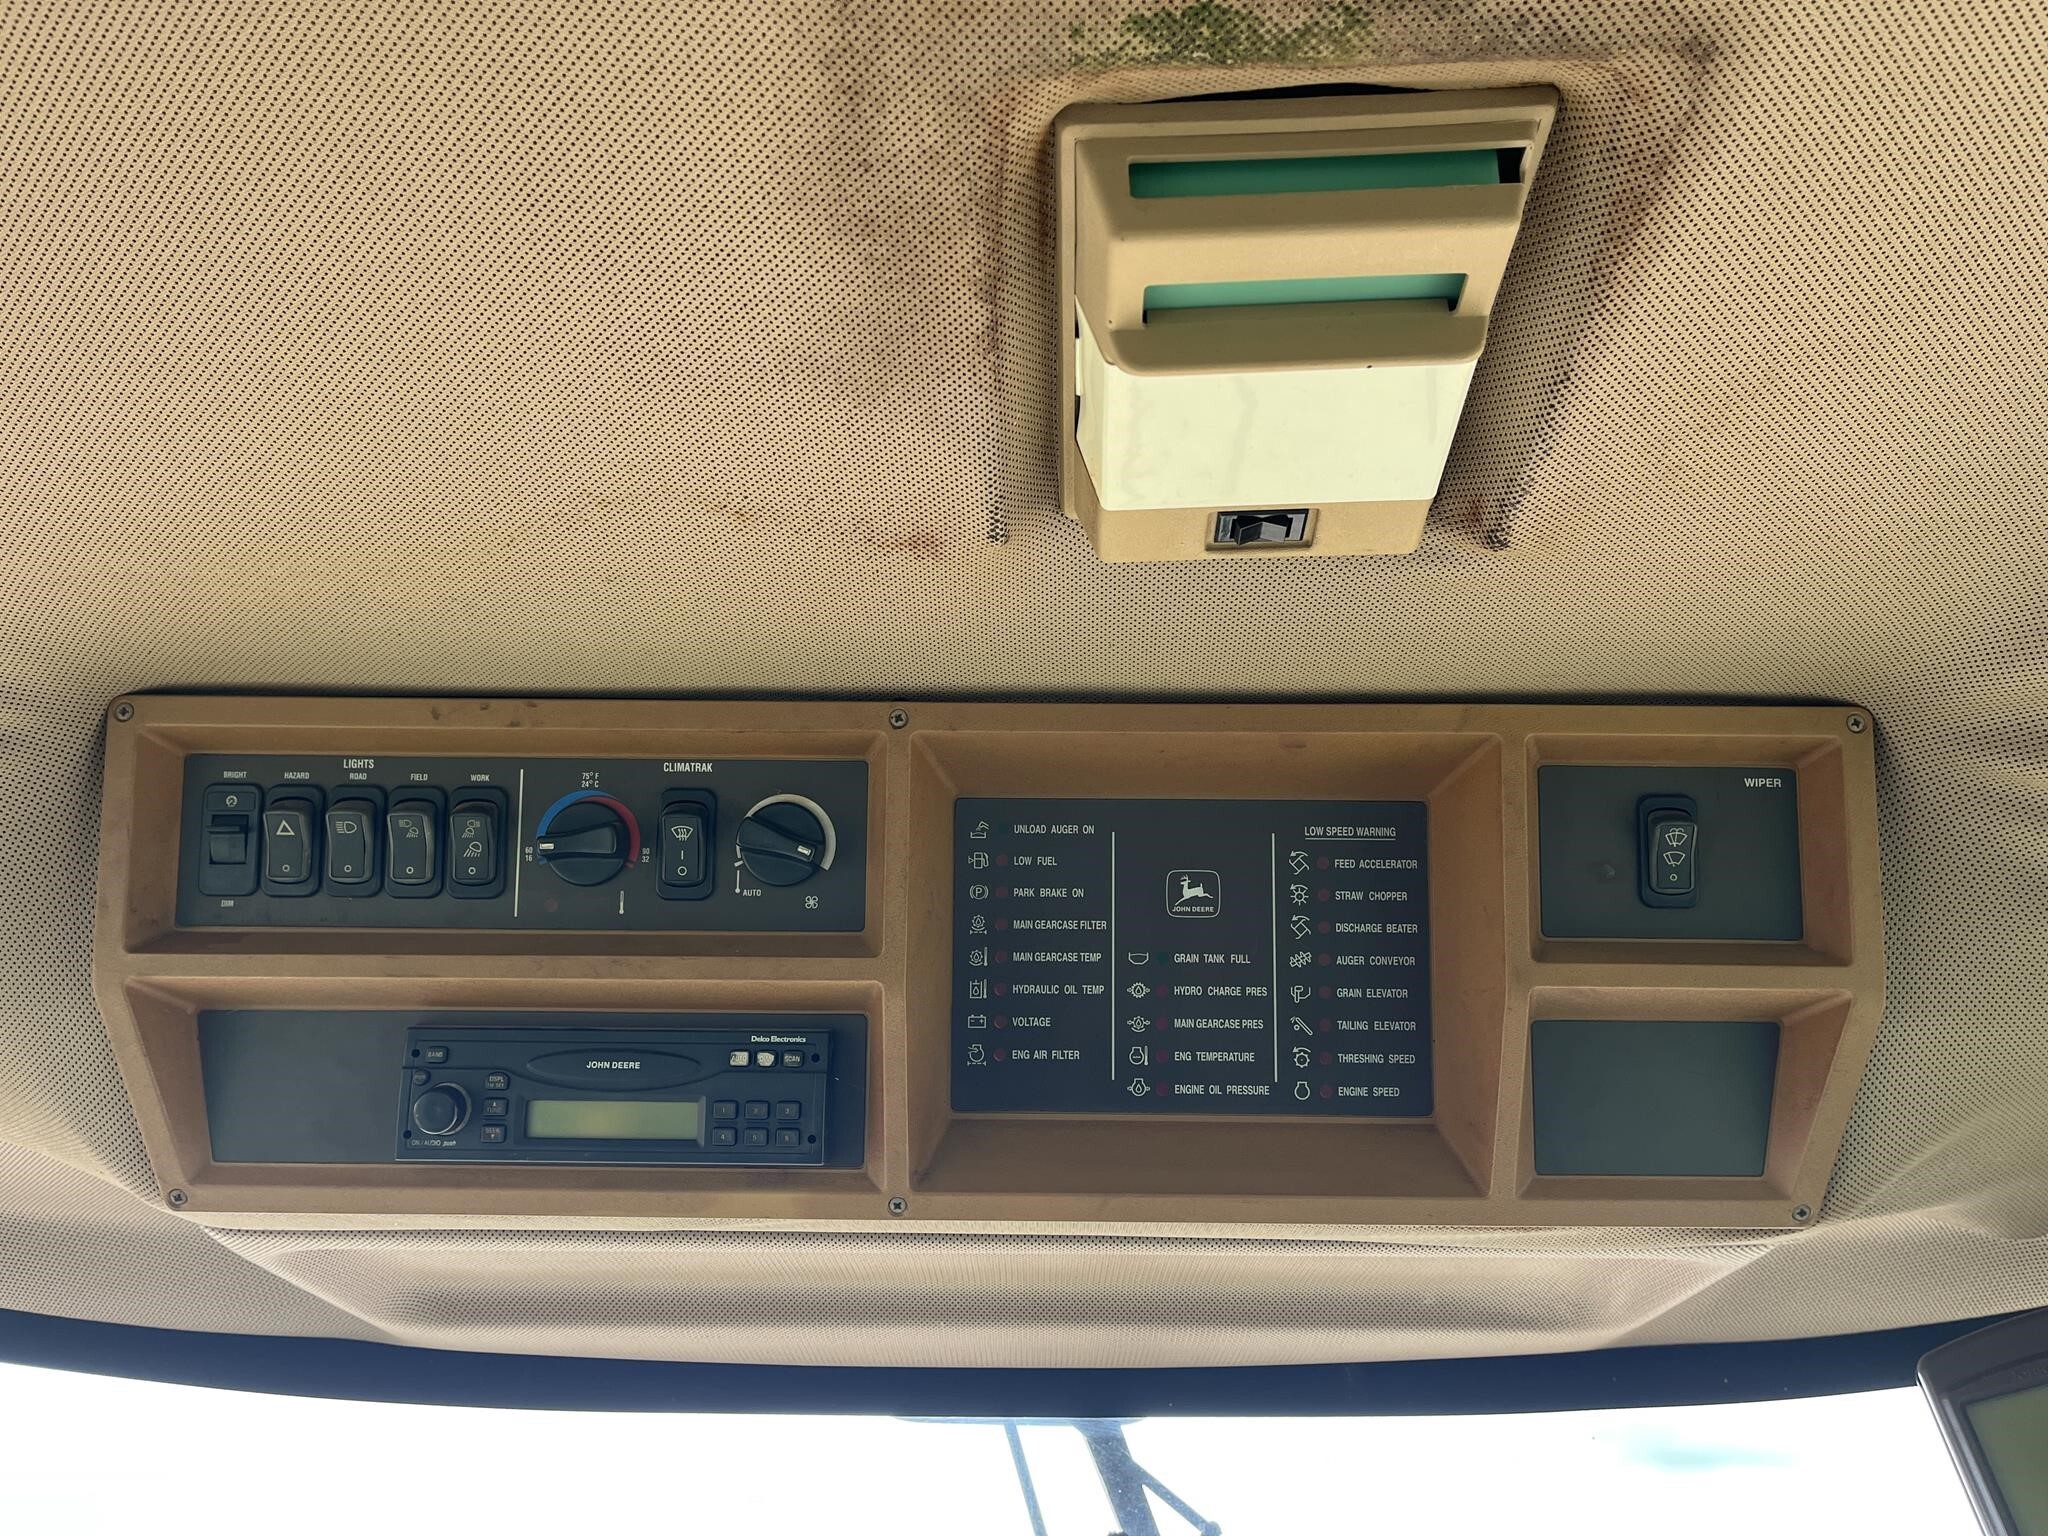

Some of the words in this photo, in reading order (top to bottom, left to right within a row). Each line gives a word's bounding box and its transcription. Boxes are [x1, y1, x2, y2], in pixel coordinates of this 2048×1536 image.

[344, 759, 374, 768] LIGHTS
[664, 763, 712, 772] CLIMATRAK
[1745, 778, 1781, 787] WIPER
[1014, 825, 1046, 833] UNLOAD
[1051, 825, 1078, 833] AUGER
[1083, 825, 1094, 834] ON
[1305, 827, 1323, 835] LOW
[1326, 827, 1354, 836] SPEED
[1356, 827, 1395, 836] WARNING
[1014, 857, 1032, 865] LOW
[1038, 857, 1056, 865] FUEL
[1335, 859, 1355, 868] FEED
[1359, 860, 1417, 868] ACCELERATOR
[1014, 888, 1034, 896] PARK
[1040, 888, 1067, 897] BRAKE
[1072, 888, 1083, 897] ON
[1336, 891, 1363, 900] STRAW
[1369, 892, 1407, 900] CHOPPER
[1014, 920, 1033, 929] MAIN
[1035, 920, 1078, 929] GEARCASE
[1080, 921, 1106, 929] FILTER
[1336, 923, 1382, 932] DISCHARGE
[1387, 924, 1417, 933] BEATER
[1013, 952, 1032, 961] MAIN
[1035, 953, 1078, 961] GEARCASE
[1080, 953, 1101, 962] TEMP
[1174, 954, 1199, 963] GRAIN
[1204, 954, 1224, 963] TANK
[1231, 954, 1250, 963] FULL
[1337, 956, 1364, 965] AUGER
[1370, 956, 1415, 965] CONVEYOR
[1013, 985, 1059, 994] HYDRAULIC
[1064, 985, 1077, 994] OIL
[1082, 985, 1104, 994] TEMP
[1174, 986, 1202, 995] HYDRO
[1208, 987, 1241, 996] CHARGE
[1246, 987, 1267, 996] PRES
[1337, 988, 1361, 997] GRAIN
[1367, 989, 1407, 998] ELEVATOR
[1013, 1017, 1050, 1026] VOLTAGE
[1175, 1019, 1194, 1028] MAIN
[1196, 1019, 1240, 1028] GEARCASE
[1242, 1020, 1263, 1028] PRES
[1338, 1021, 1368, 1030] TAILING
[1374, 1021, 1415, 1030] ELEVATOR
[1013, 1050, 1029, 1059] ENG
[1034, 1050, 1047, 1059] AIR
[1052, 1050, 1079, 1059] FILTER
[1175, 1052, 1191, 1061] ENG
[1196, 1052, 1254, 1061] TEMPERATURE
[1338, 1054, 1383, 1063] THRESHING
[1389, 1055, 1415, 1063] SPEED
[1175, 1085, 1204, 1094] ENGINE
[1209, 1085, 1221, 1094] OIL
[1227, 1085, 1269, 1095] PRESSURE
[1339, 1087, 1368, 1096] ENGINE
[1373, 1087, 1399, 1096] SPEED
